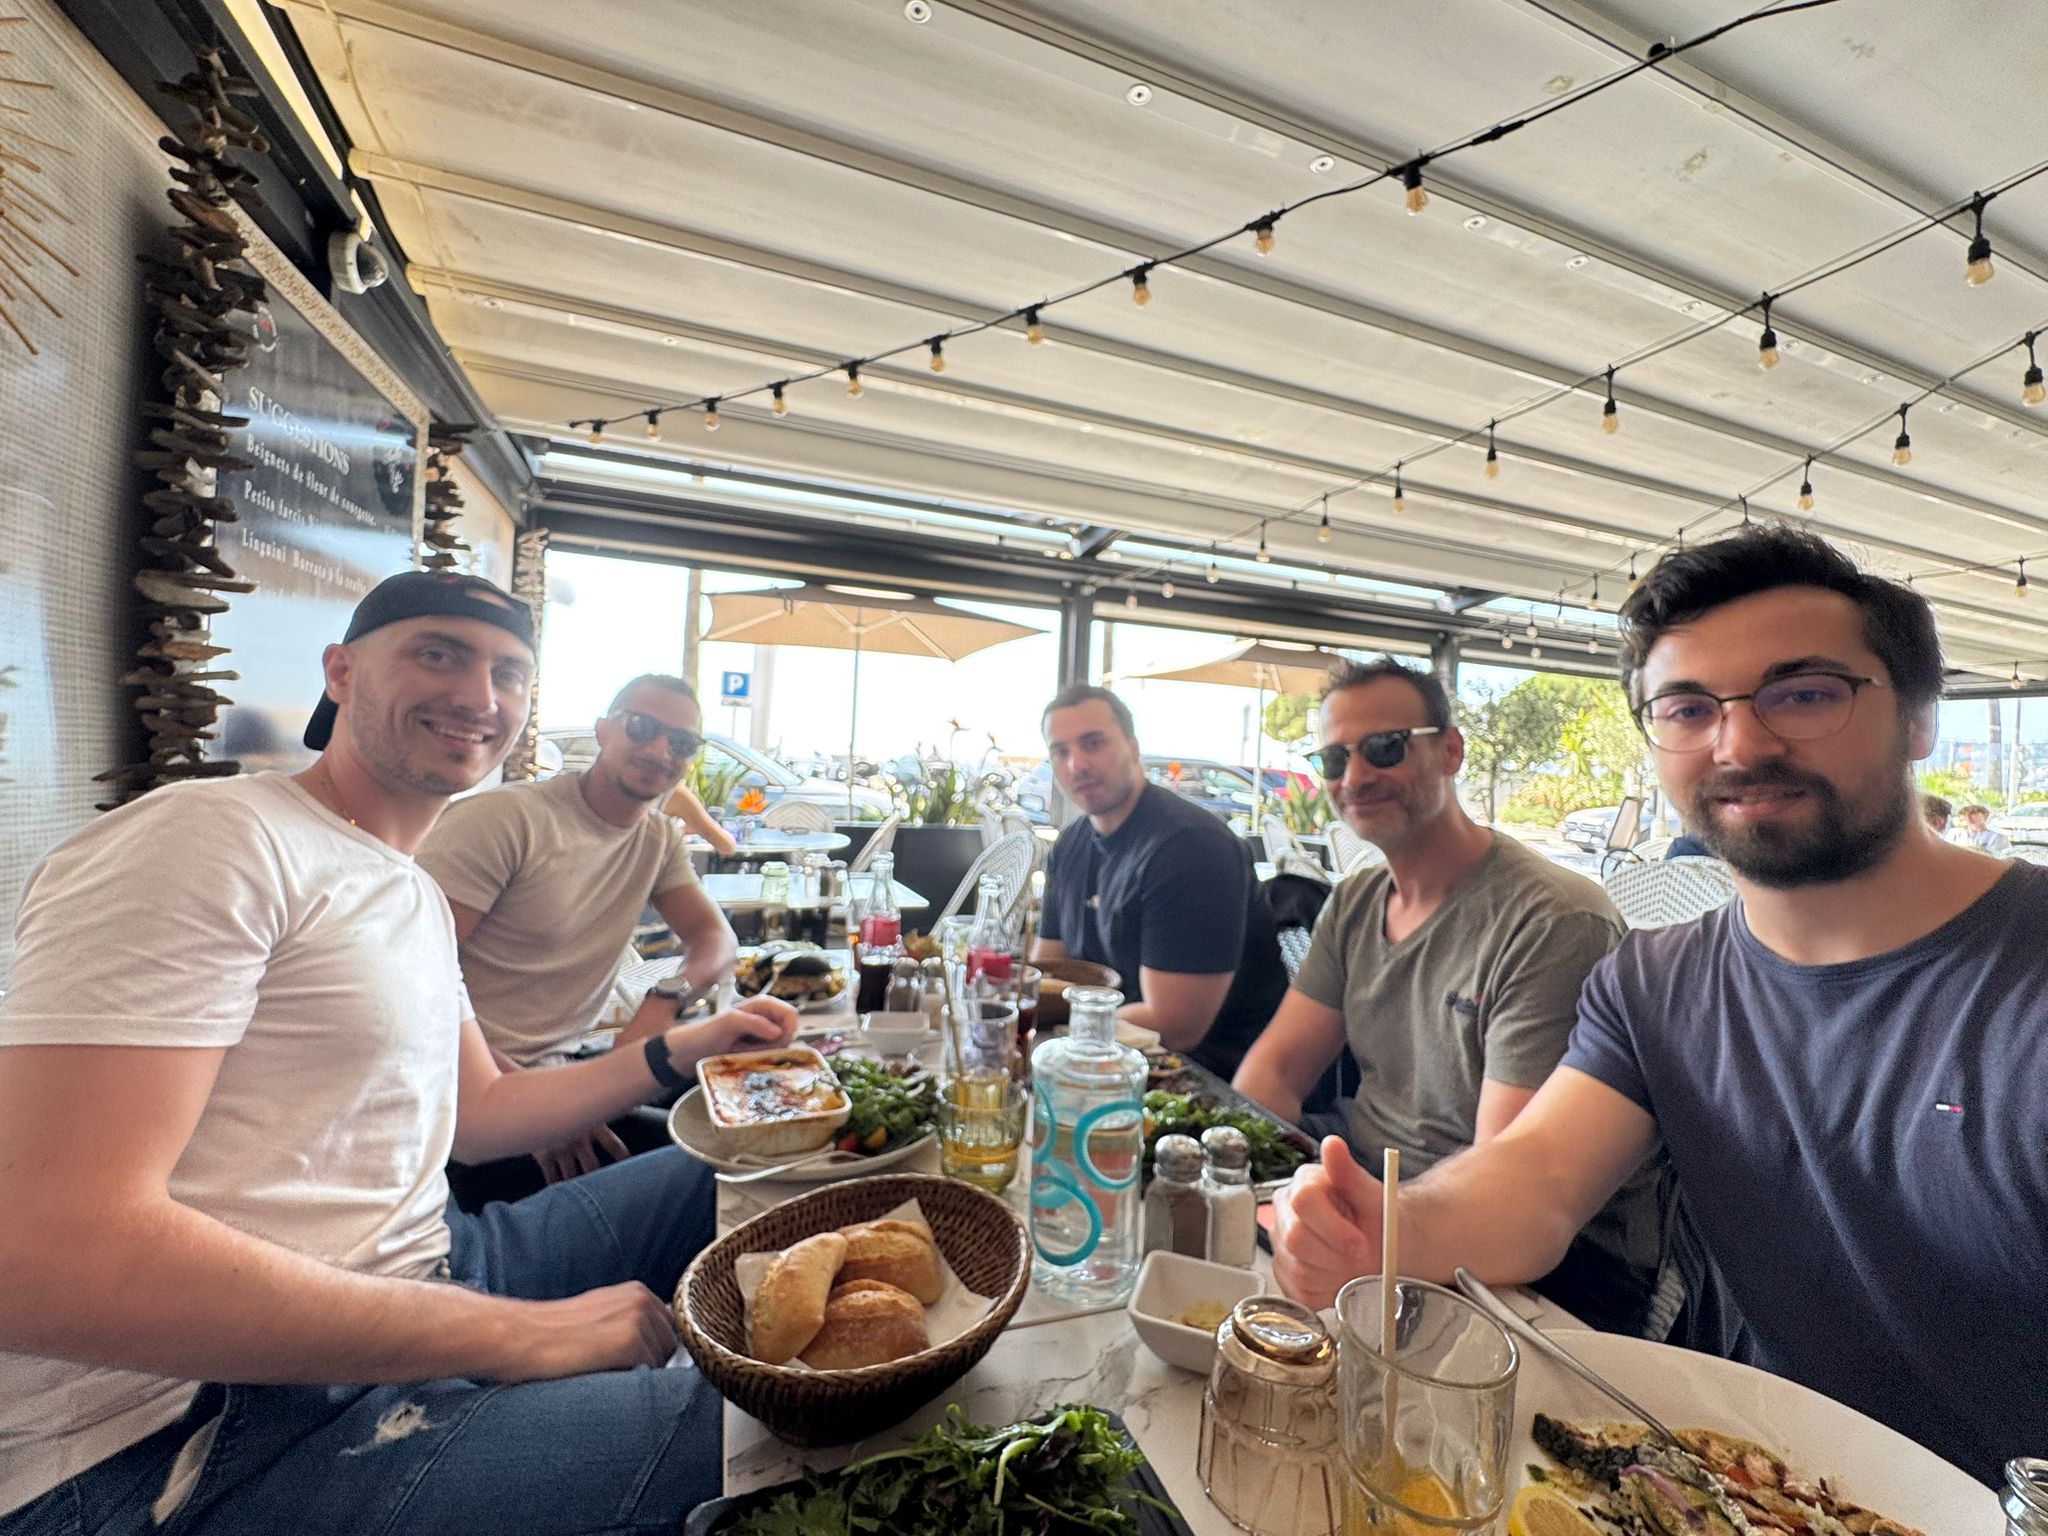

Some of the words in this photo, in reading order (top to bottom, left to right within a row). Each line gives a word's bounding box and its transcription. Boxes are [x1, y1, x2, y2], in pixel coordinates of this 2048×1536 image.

[249, 386, 350, 475] SUGGESTIONS
[247, 433, 290, 475] Beignets
[292, 463, 304, 483] de
[328, 486, 340, 505] de
[244, 480, 275, 512] Petits
[728, 674, 744, 693] P
